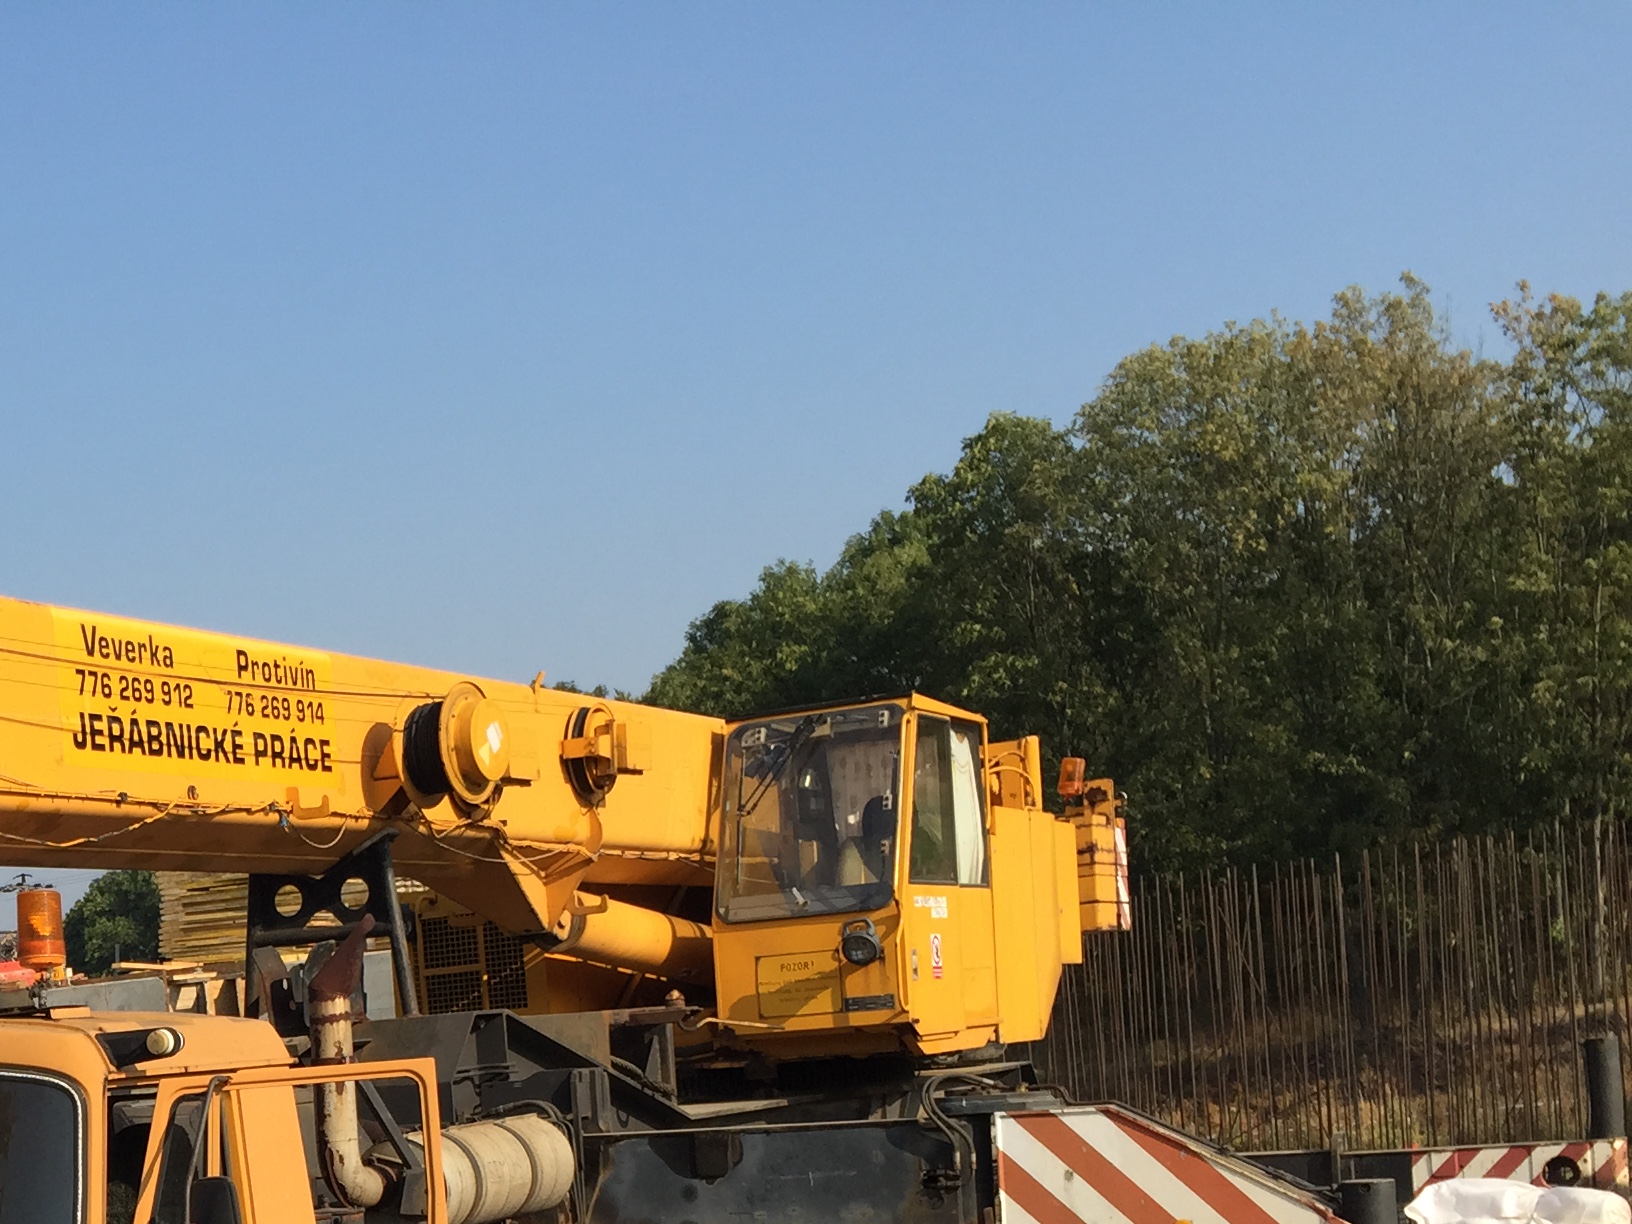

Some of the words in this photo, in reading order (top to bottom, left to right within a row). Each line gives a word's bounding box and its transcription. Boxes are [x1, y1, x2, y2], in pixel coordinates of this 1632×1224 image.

[80, 623, 174, 669] Veverka
[74, 668, 112, 699] 776
[119, 675, 155, 704] 269
[161, 680, 194, 709] 912
[236, 649, 316, 691] Protivín
[225, 690, 255, 716] 776
[260, 694, 291, 721] 269
[296, 699, 325, 725] 914
[72, 705, 246, 765] JEŘÁBNICKÉ
[253, 727, 333, 772] PRÁCE
